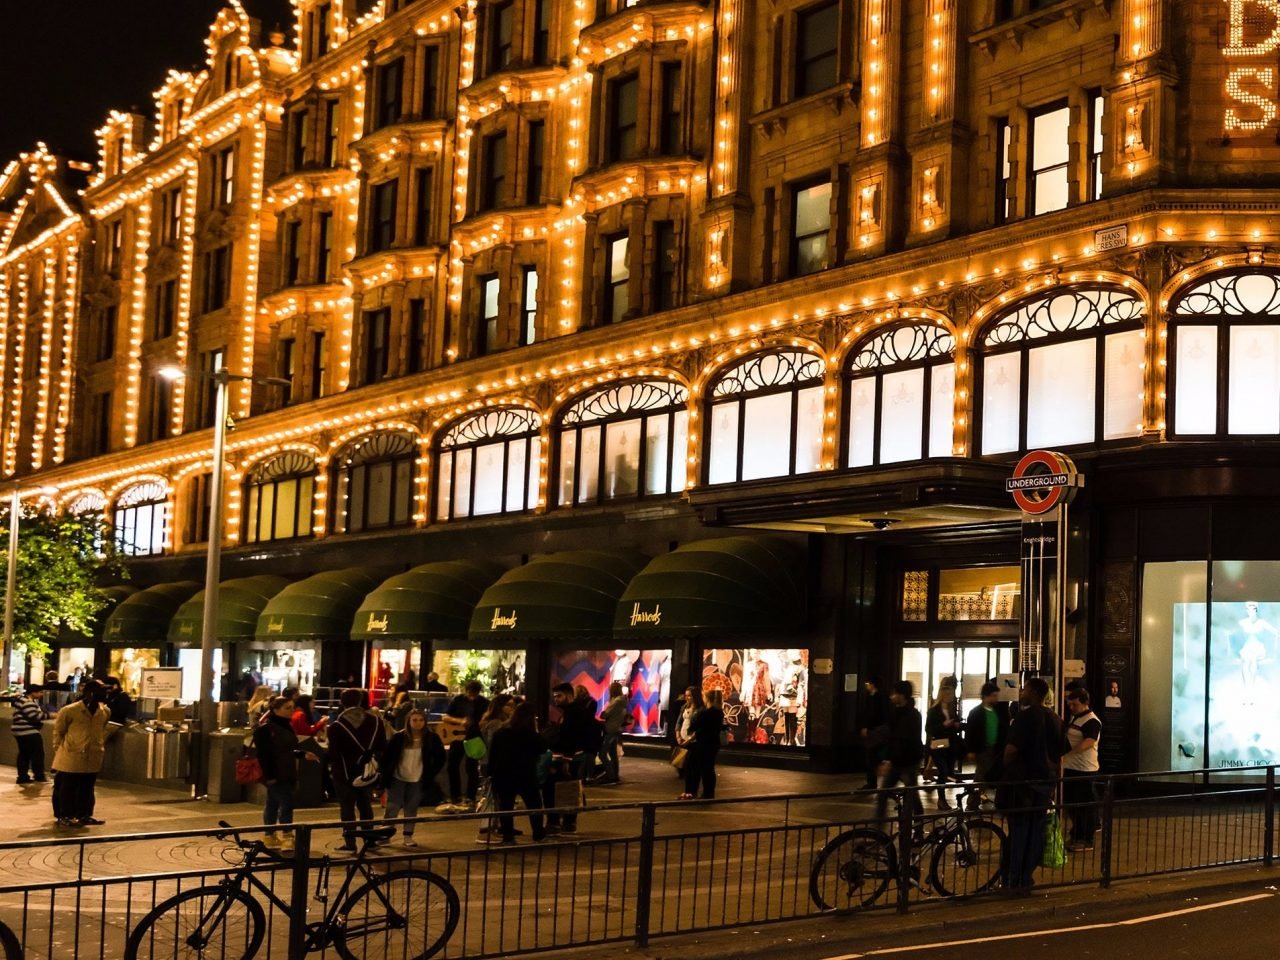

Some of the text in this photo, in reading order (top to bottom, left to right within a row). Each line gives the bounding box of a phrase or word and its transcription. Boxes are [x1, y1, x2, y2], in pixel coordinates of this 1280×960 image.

[1101, 231, 1121, 242] HANS
[1008, 474, 1067, 489] UNDERGROUND
[491, 607, 516, 629] Harrods
[630, 602, 661, 626] Harrods
[1219, 759, 1244, 768] JIMMY
